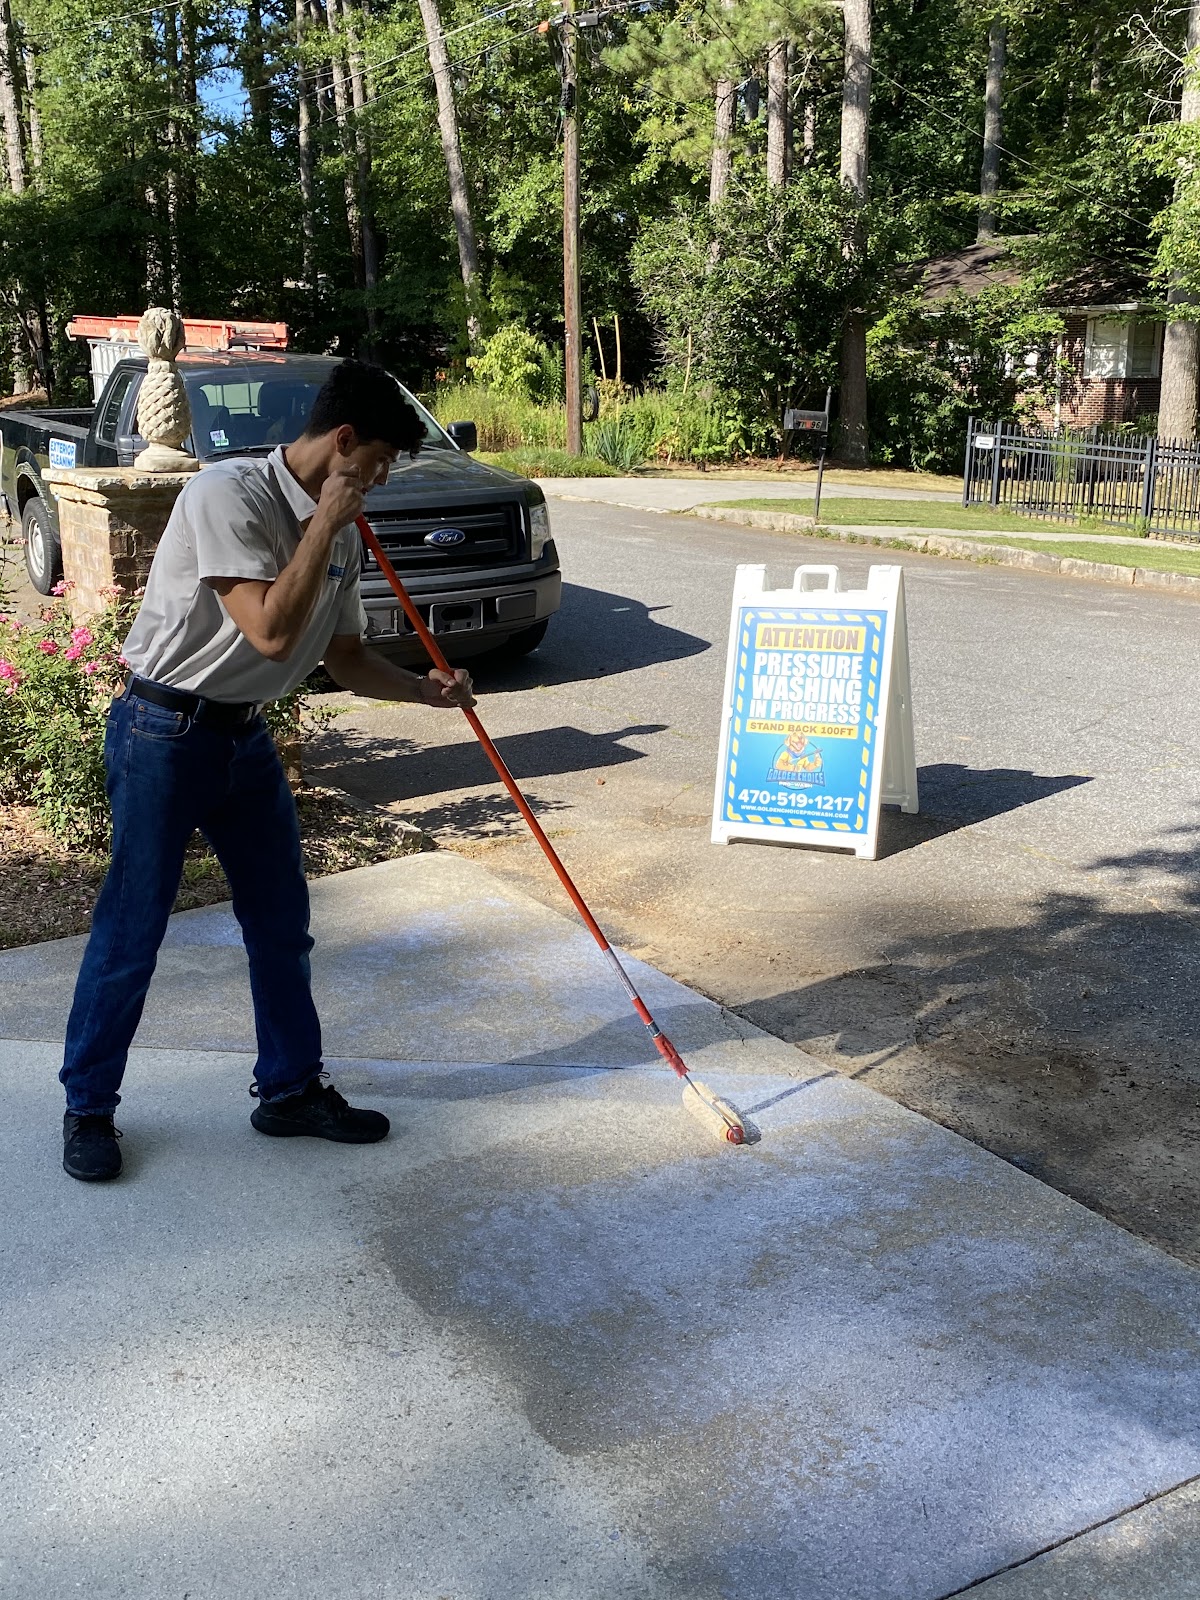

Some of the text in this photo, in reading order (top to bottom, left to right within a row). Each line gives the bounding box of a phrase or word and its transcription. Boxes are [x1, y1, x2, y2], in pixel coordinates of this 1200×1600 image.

[51, 441, 75, 456] EXTERIOR
[50, 453, 75, 468] CLEANING
[439, 532, 459, 543] Ford
[760, 627, 859, 650] ATTENTION
[753, 652, 864, 680] PRESSURE
[752, 675, 862, 705] WASHING
[749, 699, 860, 724] IN PROGRESS
[750, 721, 854, 736] STAND BACK 100FT
[767, 769, 824, 784] GOLDEN CHOICE
